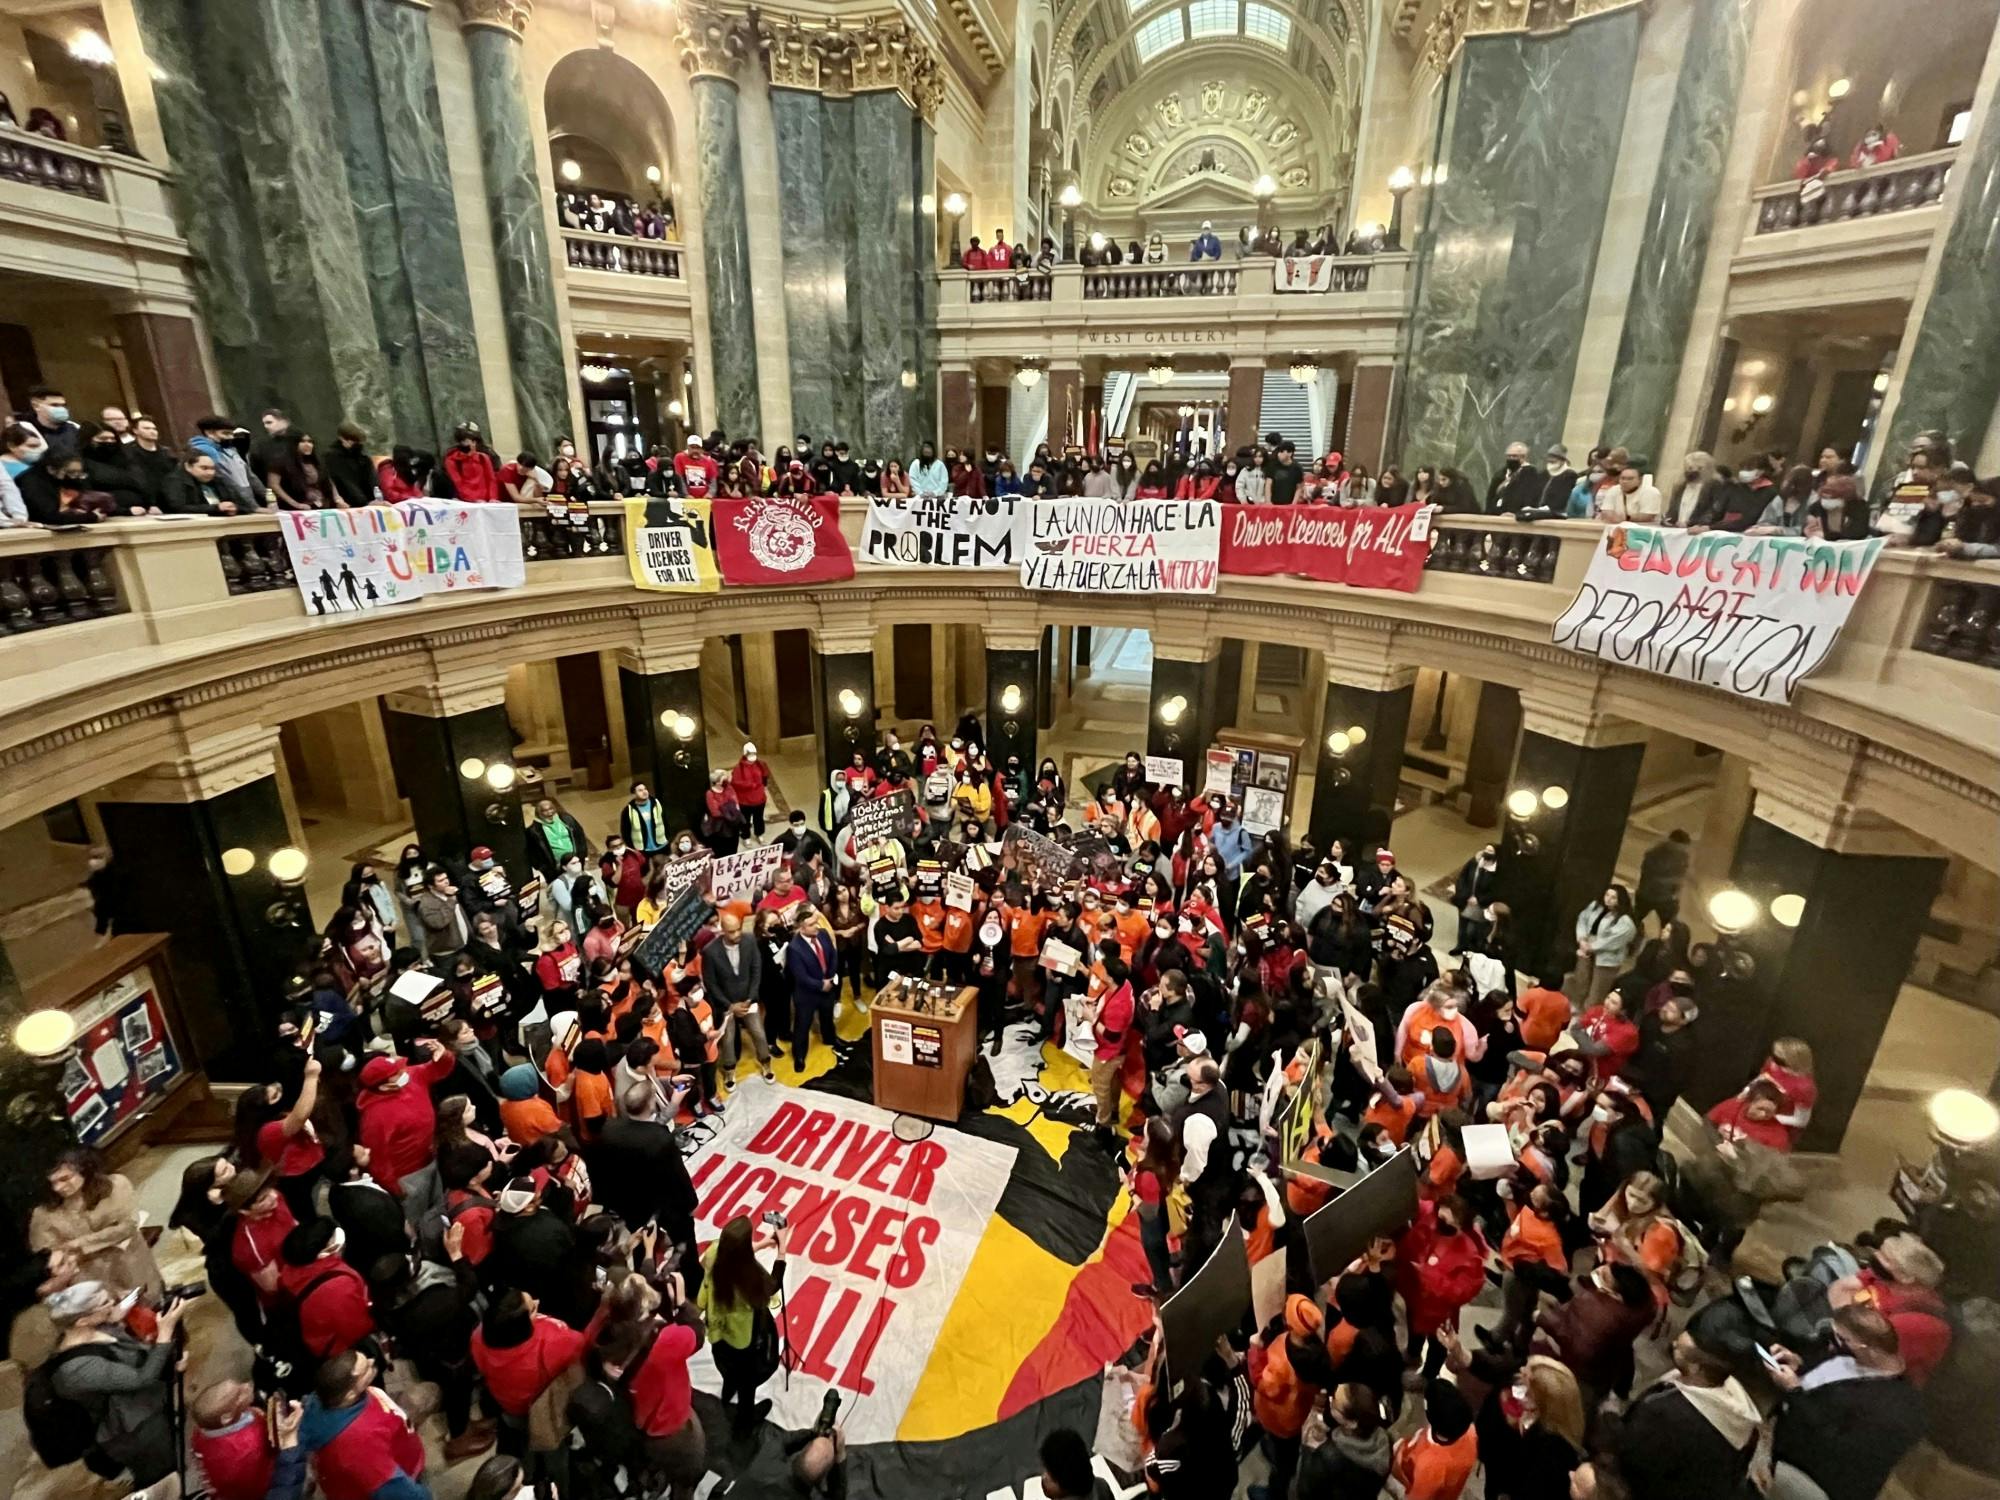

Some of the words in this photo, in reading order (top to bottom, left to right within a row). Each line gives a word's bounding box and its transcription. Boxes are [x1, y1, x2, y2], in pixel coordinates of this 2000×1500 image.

[1088, 331, 1134, 343] WEST
[1144, 330, 1226, 343] GALLERY
[772, 498, 824, 528] United
[873, 498, 907, 509] WE
[922, 498, 958, 514] ARE
[969, 497, 1021, 515] NOT
[911, 511, 951, 530] THE
[1185, 502, 1215, 530] LA
[648, 531, 682, 549] DRIVER
[1072, 534, 1157, 557] FUERZA
[1232, 510, 1284, 547] Driver
[1287, 509, 1348, 548] Licences
[1346, 509, 1374, 566] for
[386, 546, 471, 581] UNIDA
[646, 549, 690, 569] LICENSES
[1617, 528, 1887, 596] EDUCATION
[656, 569, 675, 583] FOR
[678, 568, 695, 582] ALL
[1670, 583, 1755, 622] NOT
[1552, 583, 1842, 702] DEPORTATION
[746, 1101, 948, 1206] DRIVER
[774, 1275, 898, 1396] ALL
